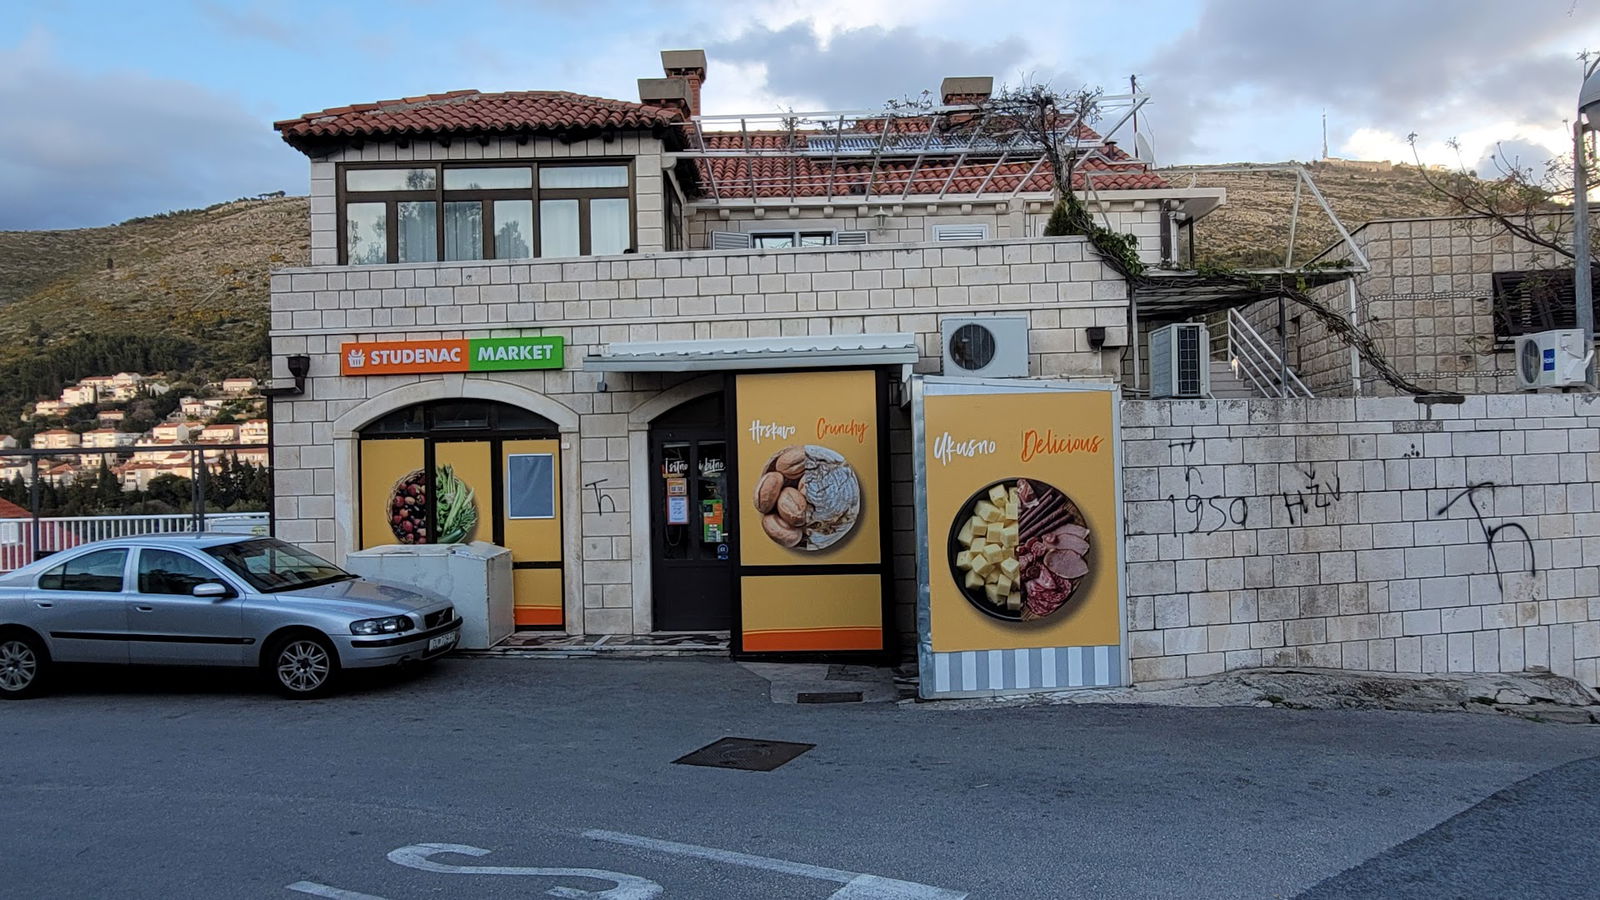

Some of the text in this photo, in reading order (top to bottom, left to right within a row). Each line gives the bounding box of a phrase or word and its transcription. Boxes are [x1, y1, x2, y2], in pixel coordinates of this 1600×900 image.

[370, 344, 554, 365] STUDENAC MARKET
[748, 419, 796, 444] Hrskavo
[815, 417, 869, 443] Crunchy
[933, 431, 996, 466] Ukusno
[1020, 429, 1104, 463] Delicious
[1166, 494, 1248, 538] 1950
